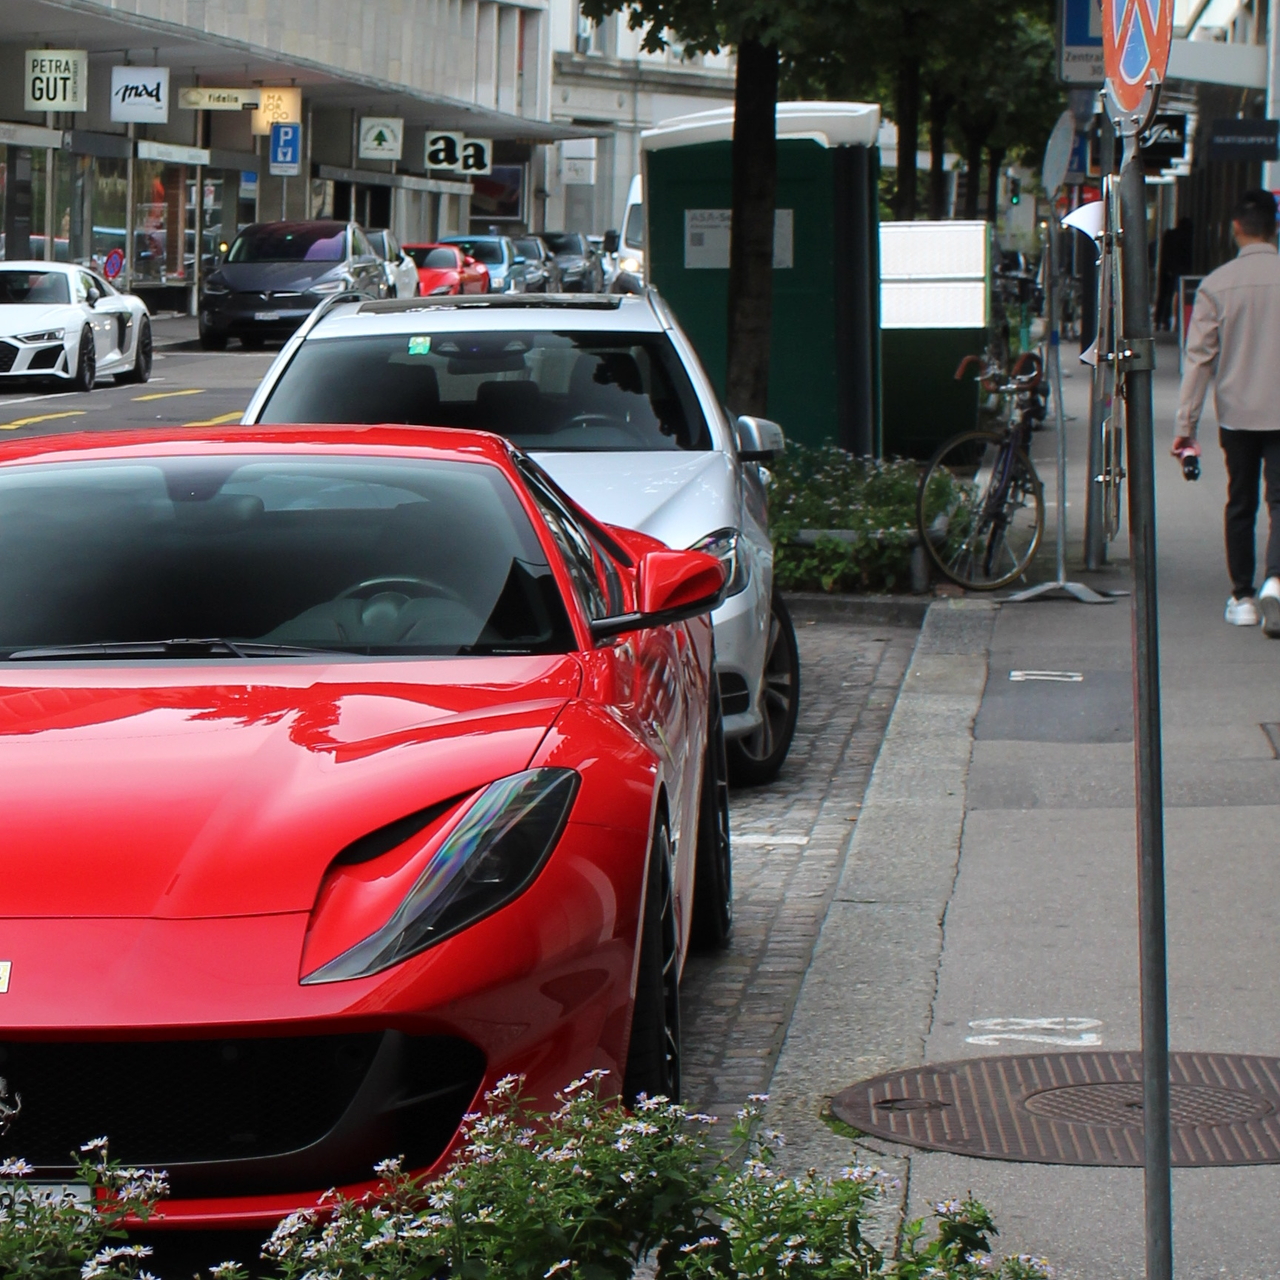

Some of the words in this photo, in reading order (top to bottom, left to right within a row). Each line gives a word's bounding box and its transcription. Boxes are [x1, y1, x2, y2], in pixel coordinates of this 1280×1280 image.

[32, 59, 70, 74] PETRA
[31, 76, 71, 102] GUT
[115, 81, 161, 102] mad
[280, 127, 293, 146] P
[428, 135, 460, 166] a
[463, 142, 488, 171] a
